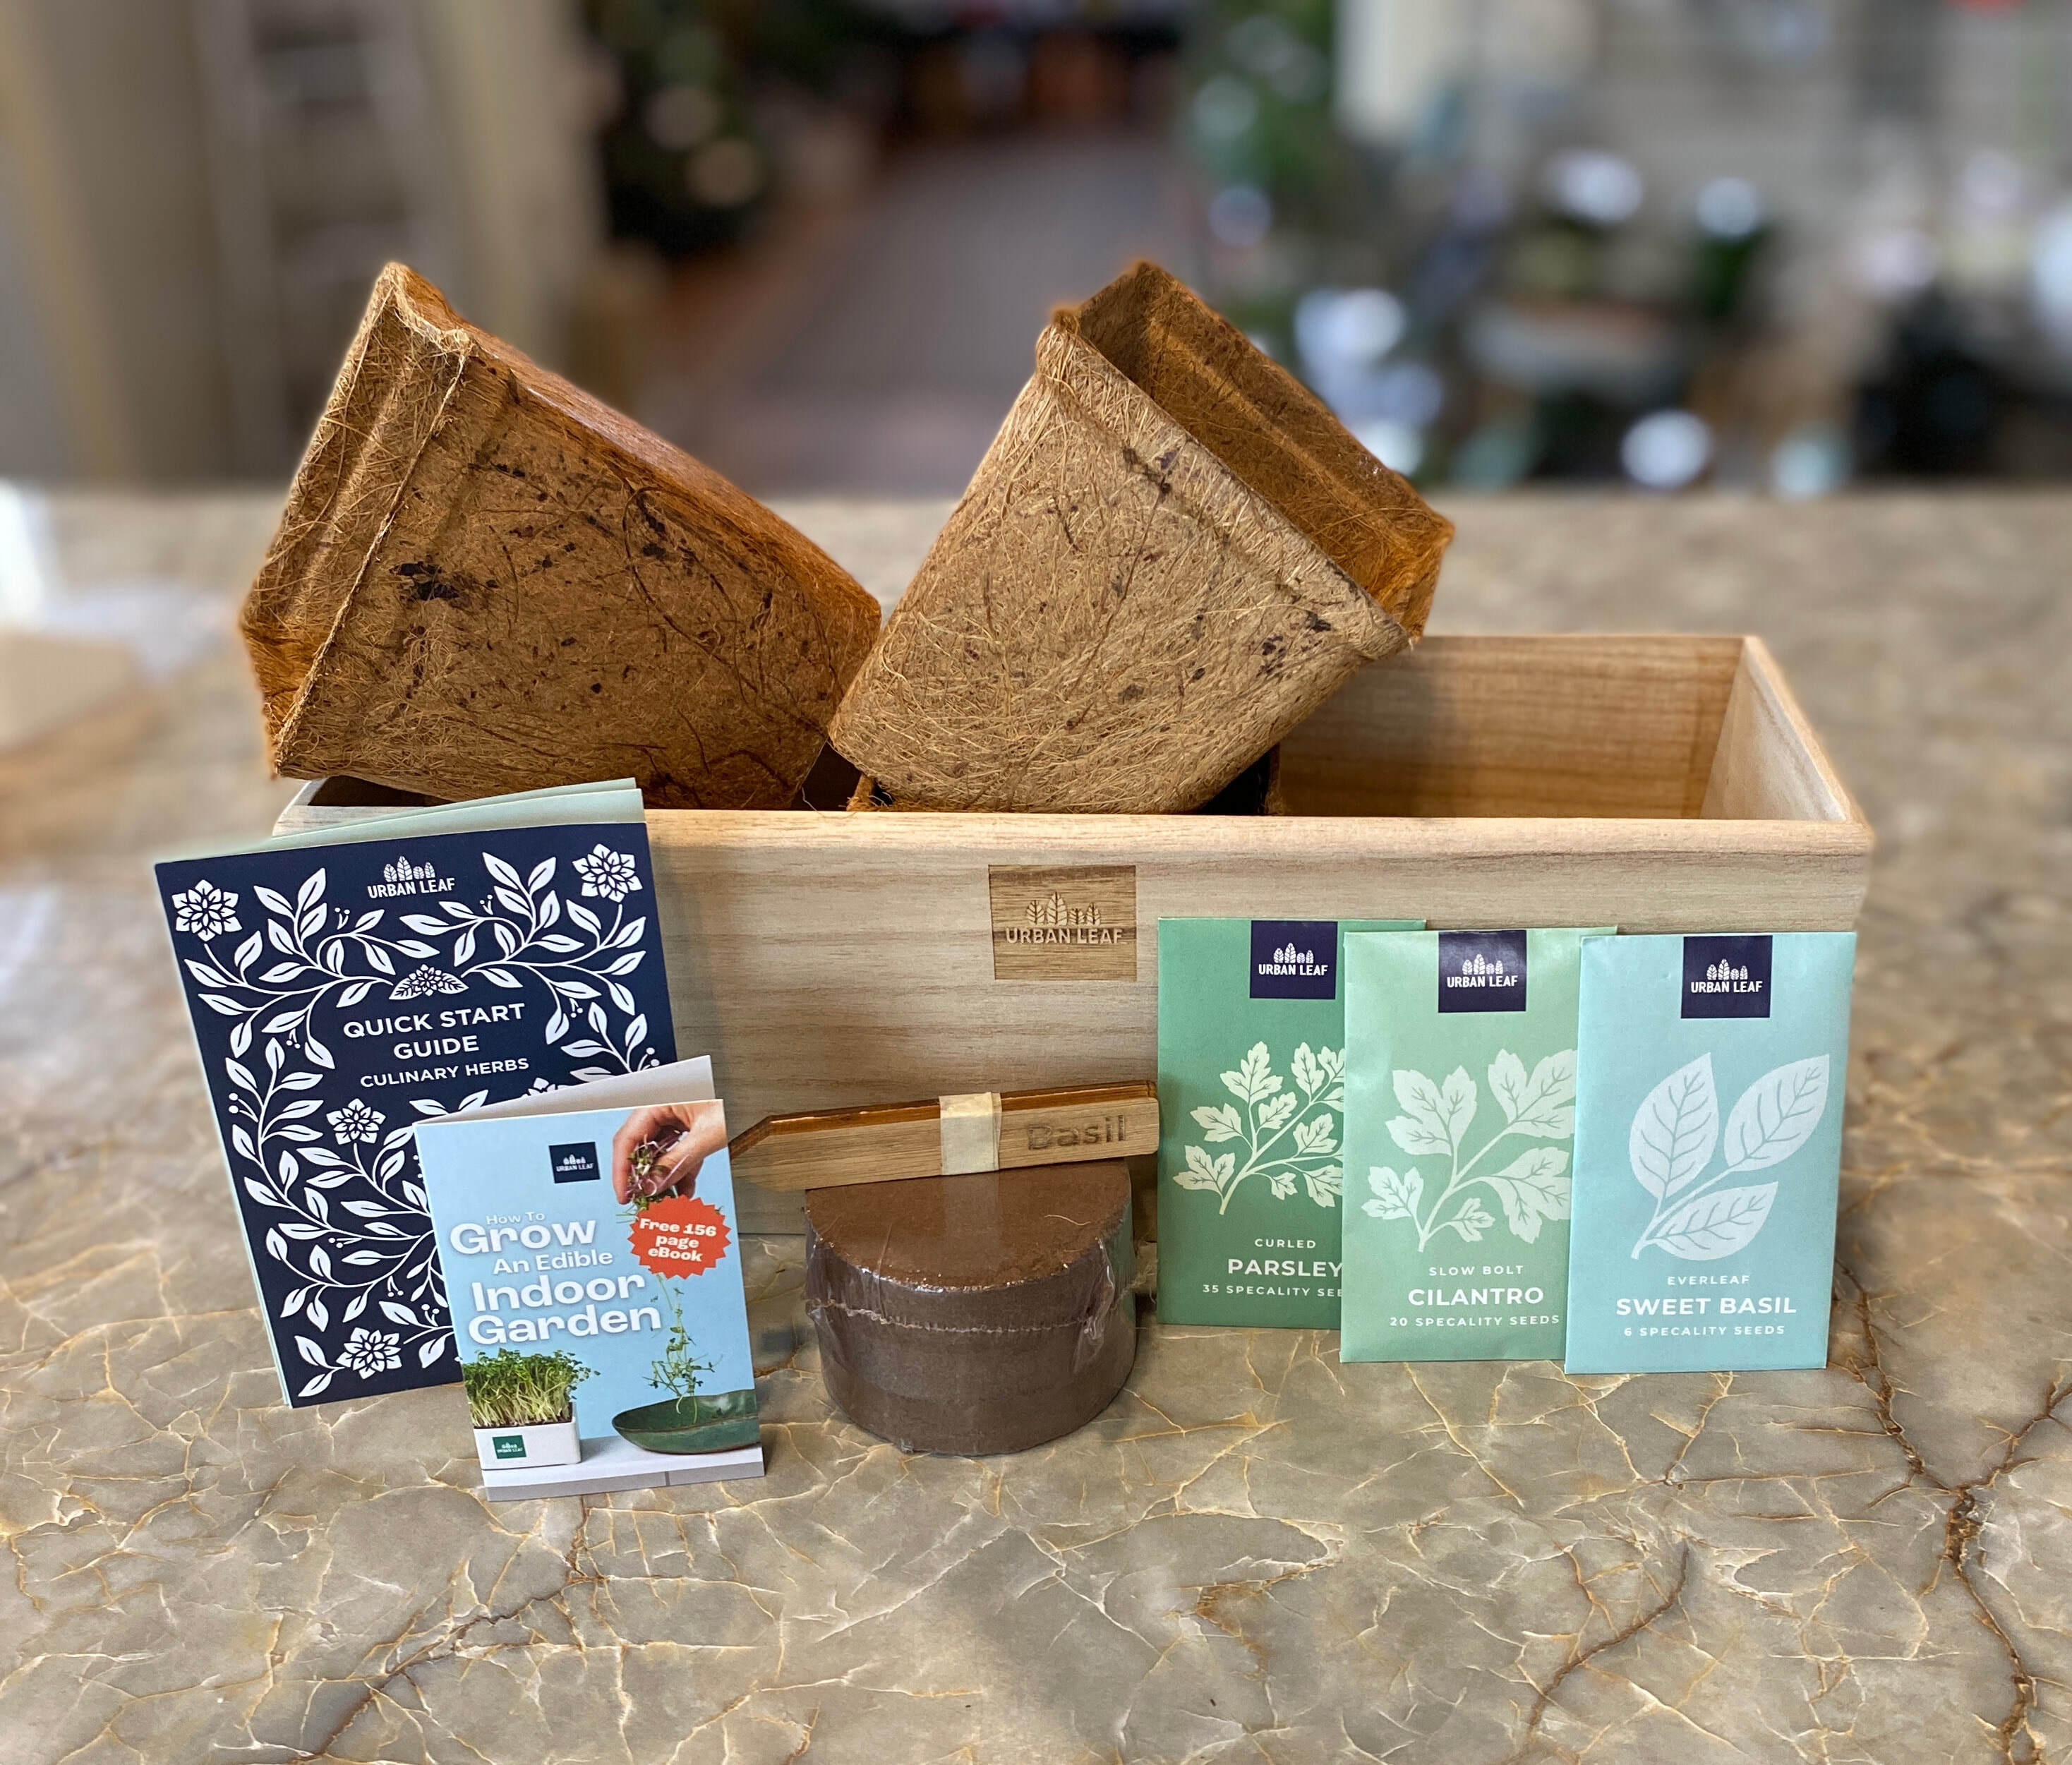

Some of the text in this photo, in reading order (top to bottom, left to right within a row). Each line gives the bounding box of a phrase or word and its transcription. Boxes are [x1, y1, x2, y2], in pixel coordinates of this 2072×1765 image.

[367, 877, 455, 898] URBAN LEAF
[1005, 927, 1123, 944] URBAN LEAF
[1258, 963, 1328, 976] URBAN LEAF
[1447, 975, 1518, 988] URBAN LEAF
[1691, 981, 1763, 993] URBAN LEAF
[343, 1003, 525, 1038] QUICK START
[393, 1035, 480, 1059] GUIDE
[360, 1058, 529, 1088] CULINARY HERBS
[1028, 1114, 1126, 1150] Basil
[486, 1212, 546, 1225] How To
[639, 1217, 717, 1237] Free 156
[450, 1219, 596, 1255] Grow
[655, 1235, 699, 1250] page
[1254, 1238, 1317, 1249] CURLED
[493, 1249, 614, 1275] An Edible
[648, 1246, 704, 1263] eBook
[1228, 1258, 1343, 1278] PARSLEY
[1428, 1265, 1524, 1277] SLOW BOLT
[1667, 1275, 1751, 1286] EVERLEAF
[471, 1274, 646, 1312] Indoor
[1202, 1284, 1343, 1297] 35 SPECALITY SEE
[1408, 1287, 1544, 1306] CILANTRO
[1615, 1296, 1797, 1316] SWEET BASIL
[468, 1304, 662, 1345] Garden
[1390, 1315, 1560, 1327] 20 SPECALITY SEEDS
[1623, 1325, 1785, 1337] 6 SPECALITY SEEDS
